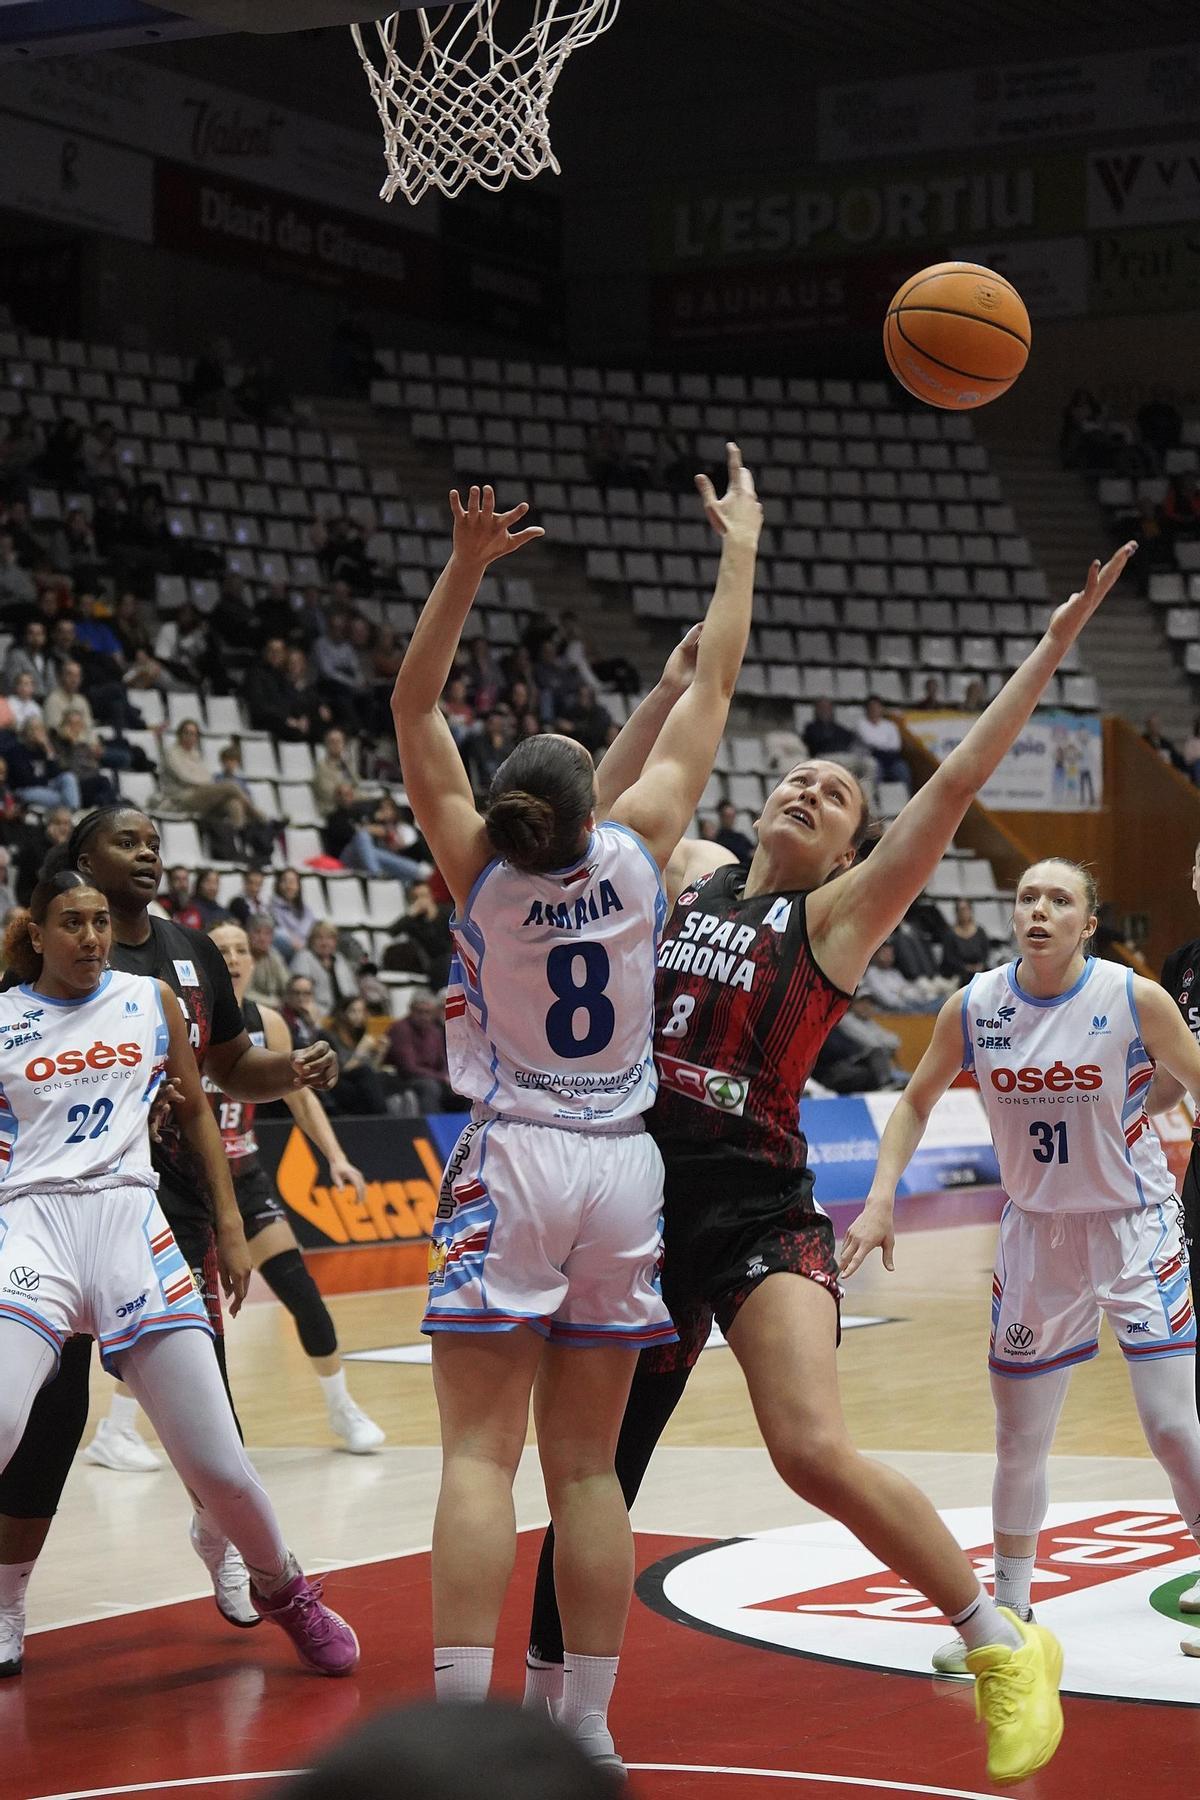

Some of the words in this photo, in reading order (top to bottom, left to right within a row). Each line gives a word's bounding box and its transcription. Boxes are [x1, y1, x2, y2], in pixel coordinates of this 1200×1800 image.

[277, 211, 313, 254] de
[672, 169, 1035, 258] L'ESPORTIU
[522, 878, 624, 930] AMAIA
[679, 911, 757, 954] SPAR
[657, 940, 756, 992] GIRONA
[545, 941, 615, 1058] 8
[662, 994, 696, 1039] 8
[976, 1018, 1003, 1029] ardoi
[33, 1070, 137, 1095] CONSTRUCCIÓ
[997, 1094, 1101, 1106] CONSTRUCCIÓN
[64, 1097, 114, 1144] 22
[220, 1103, 242, 1130] 13
[1029, 1121, 1069, 1164] 31
